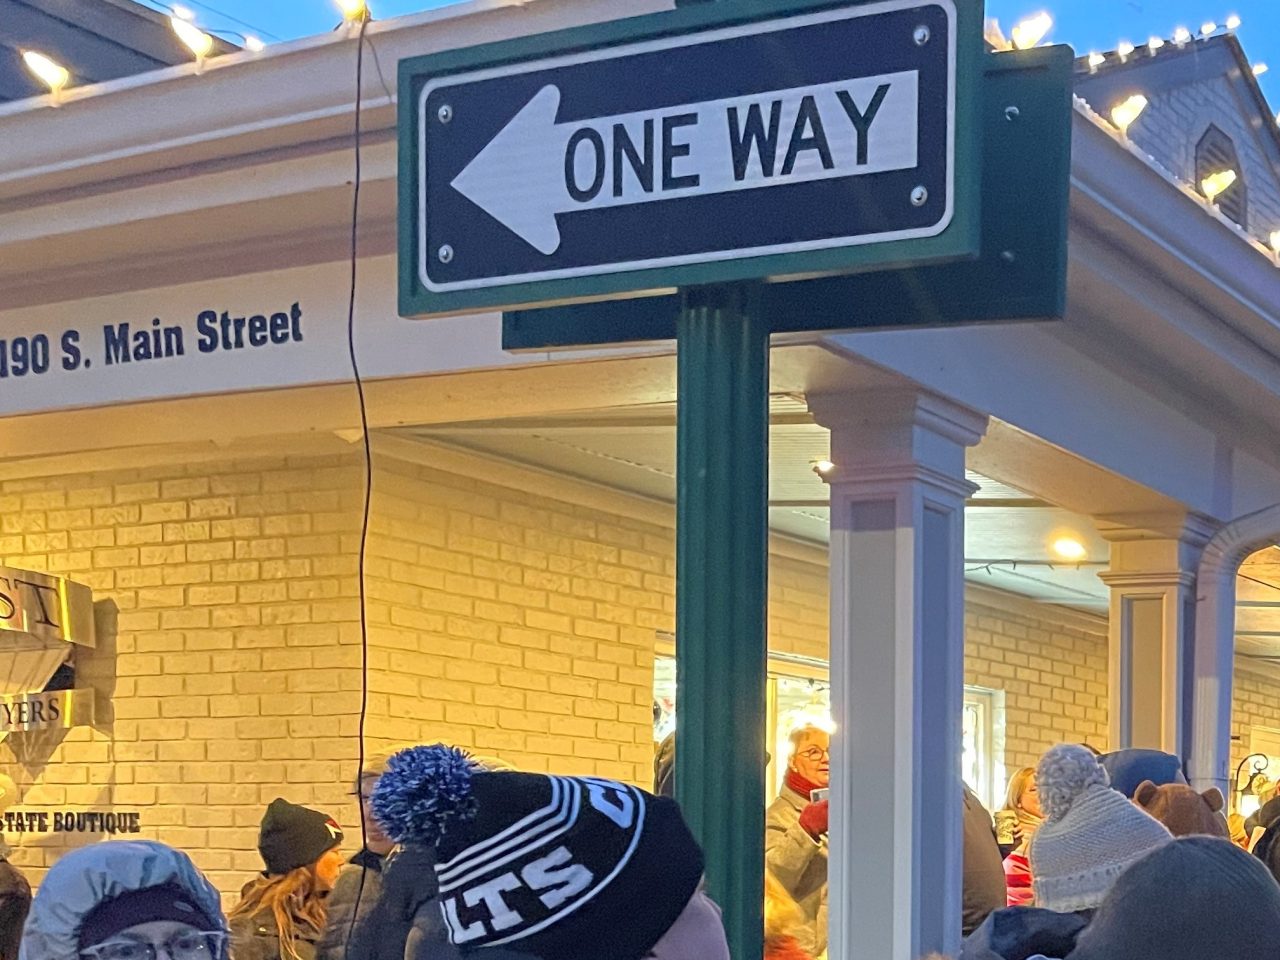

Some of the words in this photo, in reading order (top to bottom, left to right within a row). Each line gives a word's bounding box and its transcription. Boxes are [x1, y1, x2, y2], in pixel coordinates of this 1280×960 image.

[564, 112, 700, 203] ONE
[727, 83, 892, 181] WAY
[0, 333, 50, 378] 190
[61, 329, 91, 371] S.
[103, 317, 185, 366] Main
[196, 301, 303, 353] Street
[1, 697, 60, 725] YERS
[53, 811, 140, 834] BOUTIQUE
